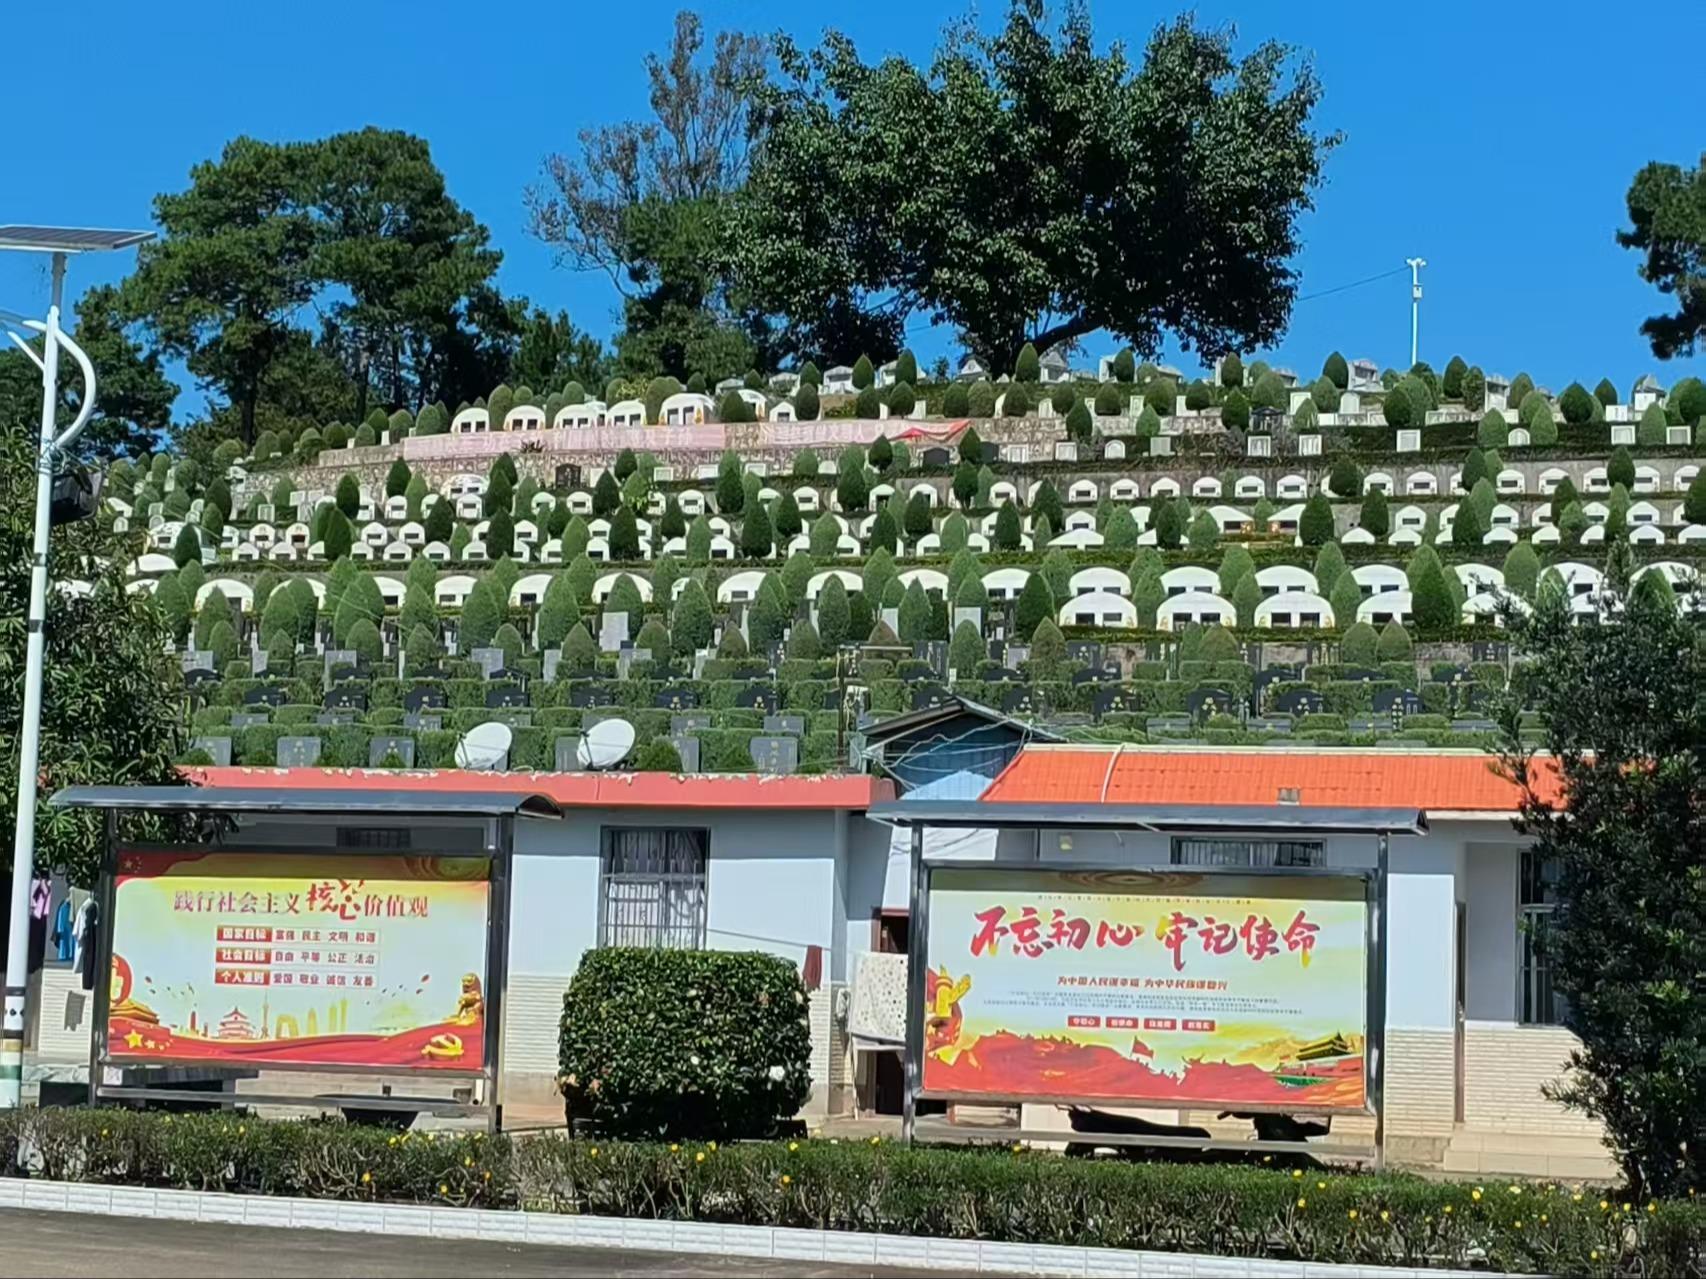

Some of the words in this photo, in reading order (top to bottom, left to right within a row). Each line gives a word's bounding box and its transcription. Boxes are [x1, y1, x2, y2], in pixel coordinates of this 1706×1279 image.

[174, 880, 429, 920] 践行社会主义核心价值观
[302, 930, 321, 942] 民主
[328, 931, 349, 943] 文明
[970, 905, 1146, 958] 不忘初心
[1155, 910, 1322, 972] 牢记使命
[275, 951, 294, 962] 自由
[301, 951, 320, 963] 平等
[328, 952, 347, 964] 公正
